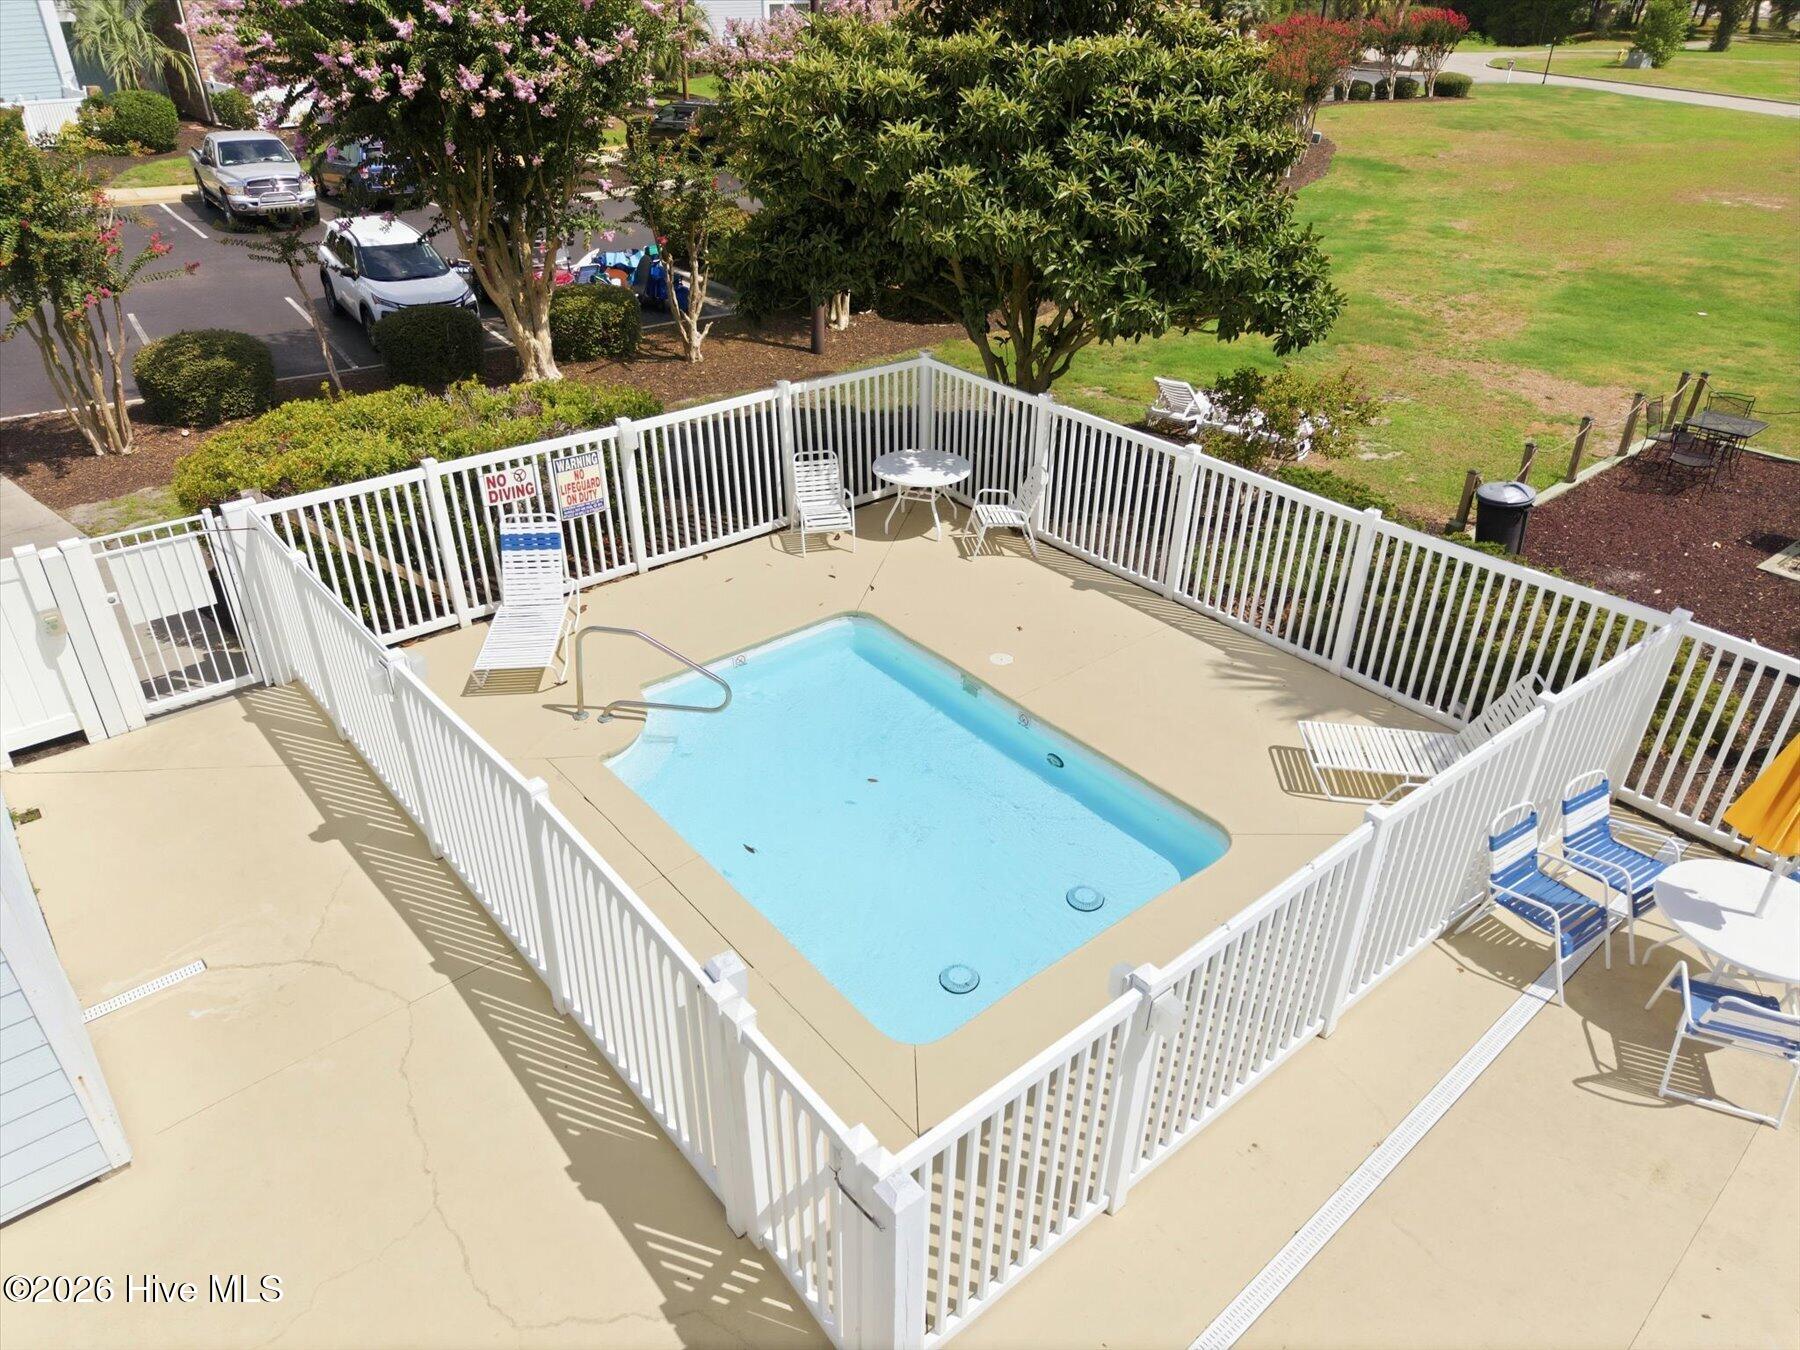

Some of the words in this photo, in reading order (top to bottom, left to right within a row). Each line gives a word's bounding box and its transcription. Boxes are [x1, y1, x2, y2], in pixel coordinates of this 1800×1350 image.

[556, 453, 598, 472] WARNING
[486, 474, 506, 489] NO
[573, 469, 585, 480] NO
[488, 482, 534, 504] DIVING
[560, 476, 601, 495] LIFEGUARD
[566, 494, 578, 505] ON
[579, 490, 598, 503] DUTY
